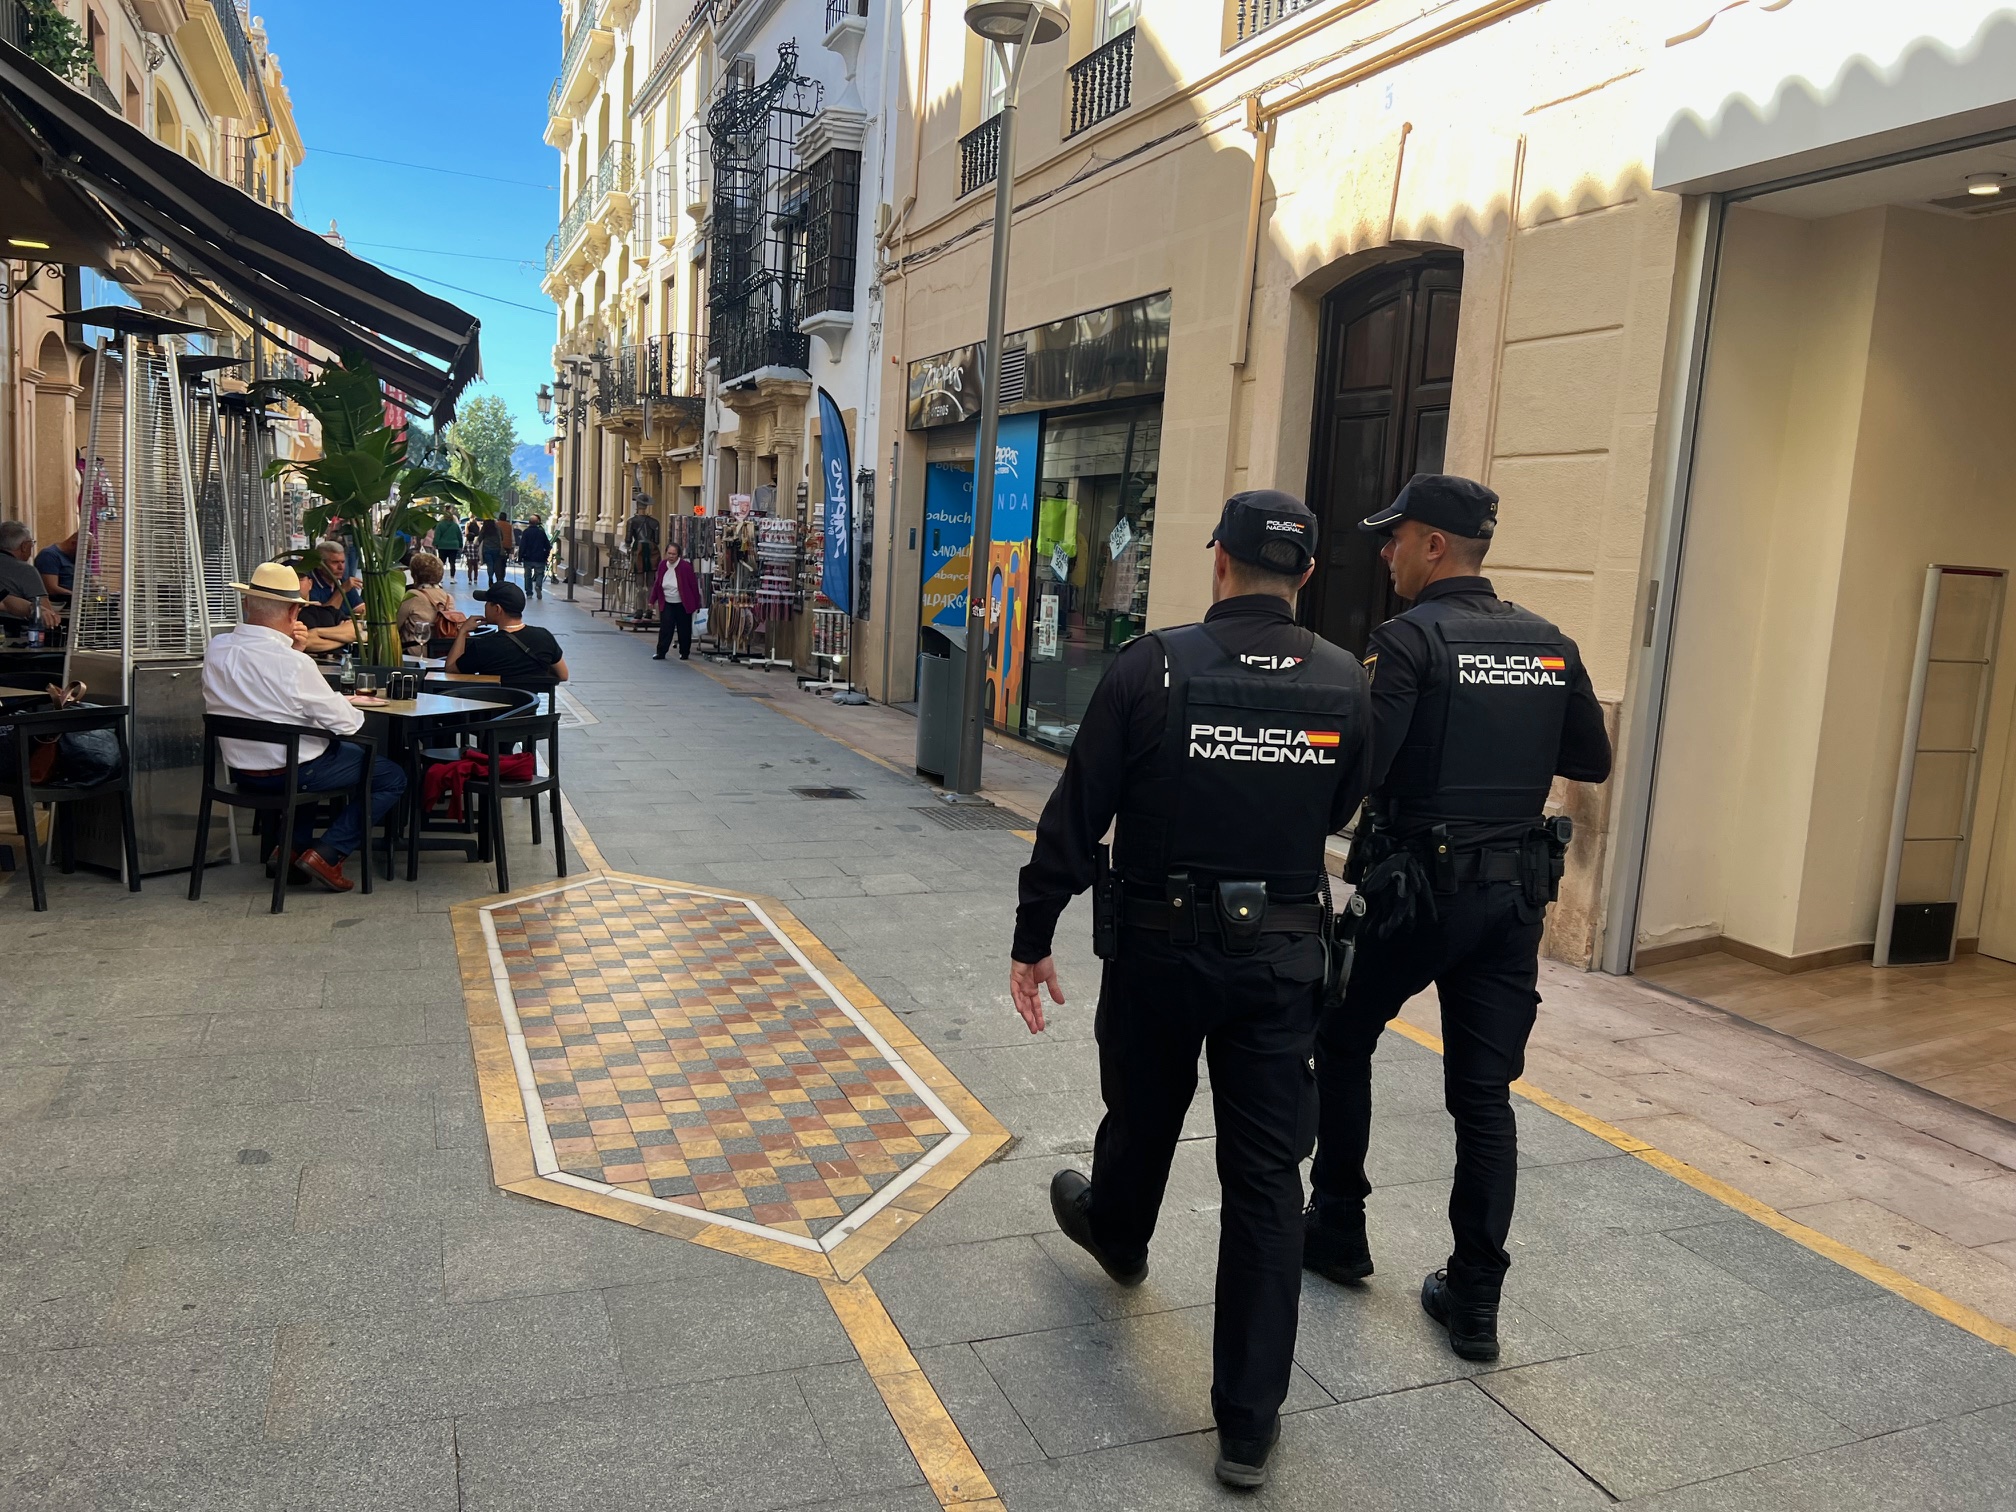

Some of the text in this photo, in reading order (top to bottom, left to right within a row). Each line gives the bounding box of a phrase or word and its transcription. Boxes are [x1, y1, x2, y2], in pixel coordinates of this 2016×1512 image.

[995, 446, 1019, 465] appas
[962, 481, 974, 493] CH
[1265, 525, 1304, 534] NACIONAL
[933, 570, 969, 581] abarca
[1459, 669, 1566, 686] NACIONAL
[1189, 742, 1336, 765] NACIONAL
